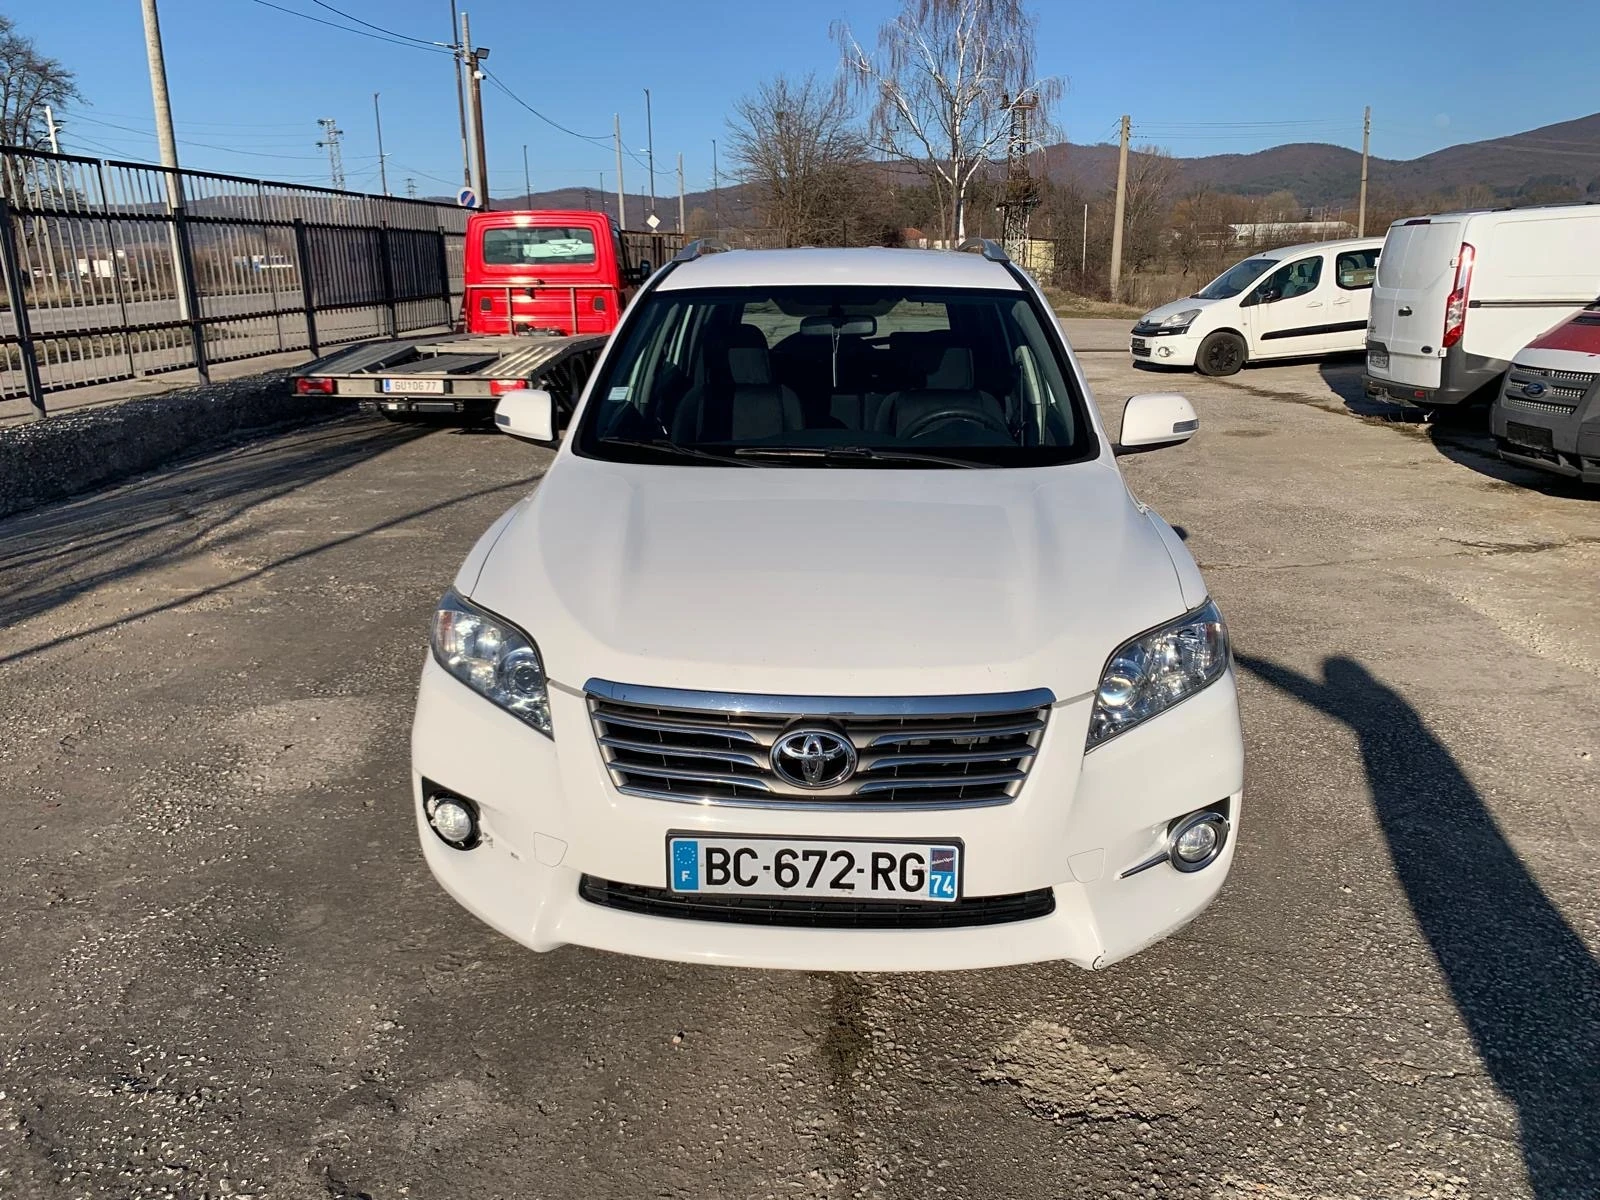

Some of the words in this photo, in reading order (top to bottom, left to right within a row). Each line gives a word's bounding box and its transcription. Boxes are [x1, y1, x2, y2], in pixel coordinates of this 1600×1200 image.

[681, 870, 691, 882] F
[704, 846, 926, 893] BC-672-RG
[930, 874, 954, 895] 74
